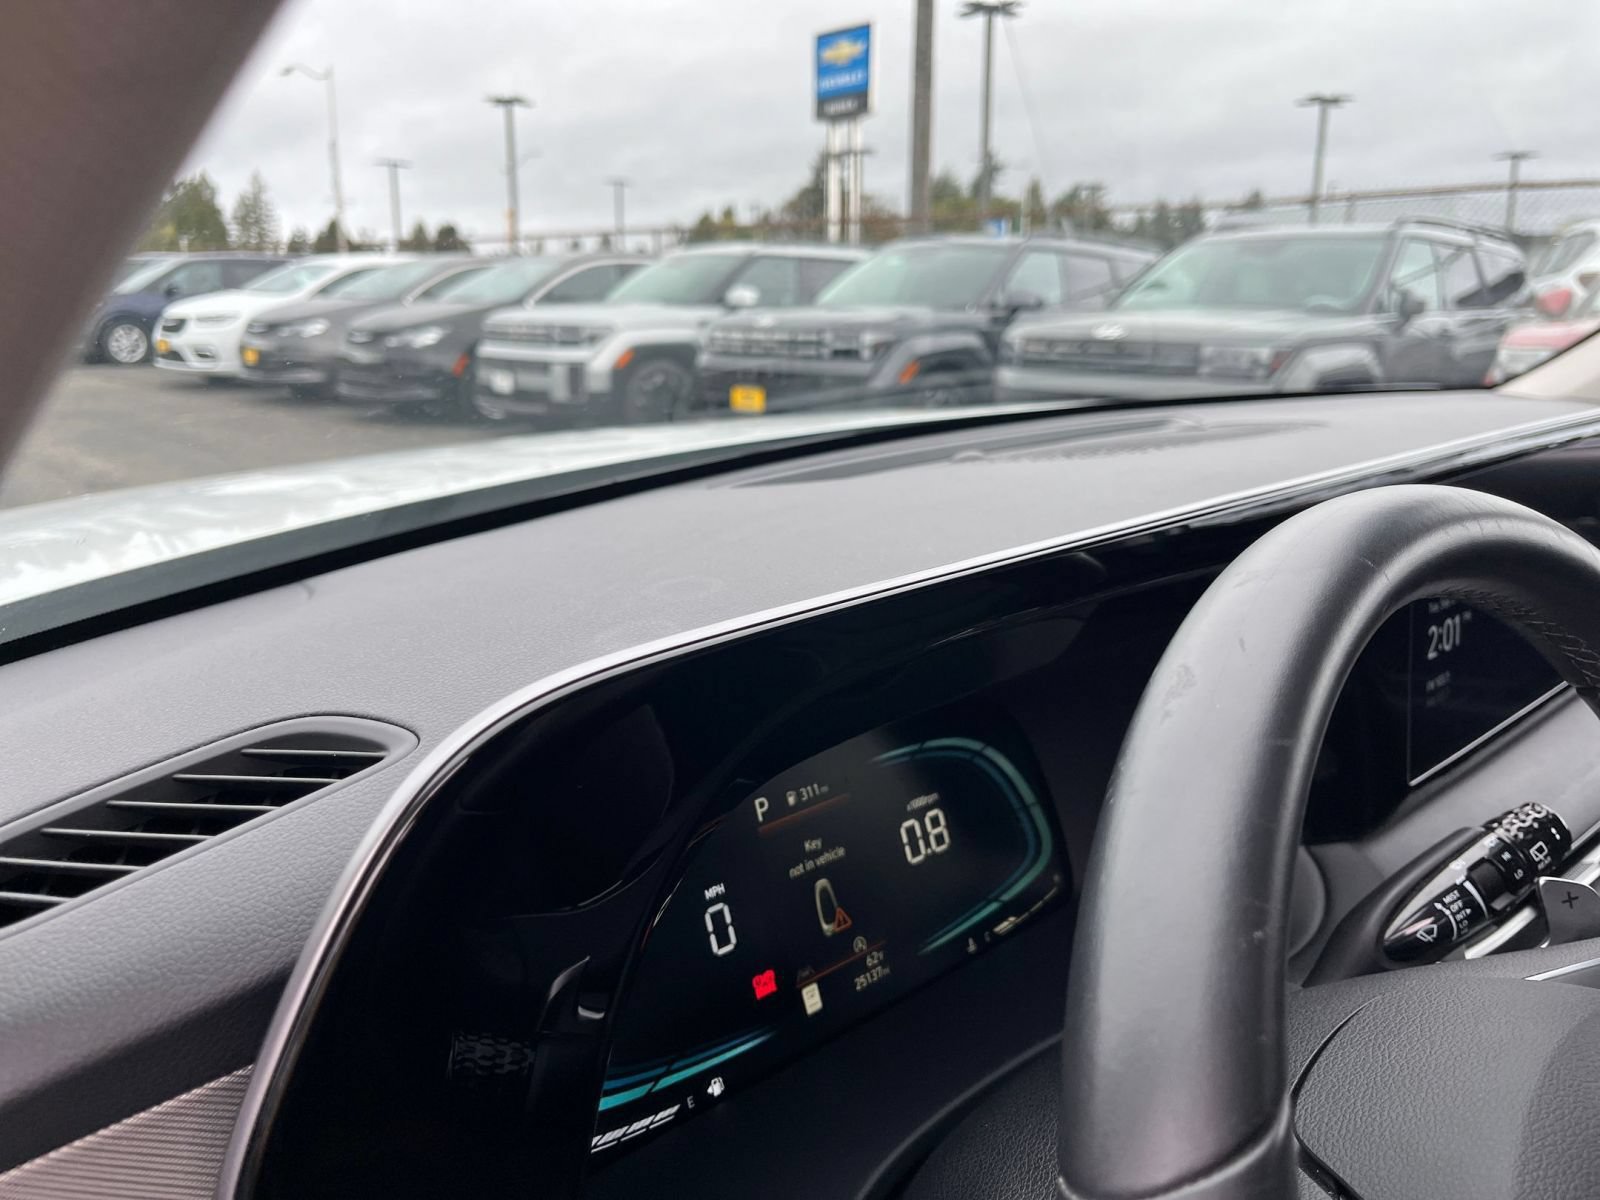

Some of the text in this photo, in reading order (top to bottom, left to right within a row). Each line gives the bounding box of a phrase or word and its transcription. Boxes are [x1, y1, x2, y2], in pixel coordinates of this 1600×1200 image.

[1427, 614, 1460, 660] 2:01
[754, 797, 769, 822] P
[804, 838, 822, 852] Key
[900, 808, 950, 865] 0.8
[789, 847, 845, 879] not in vehicle
[704, 882, 725, 900] MPH
[1442, 890, 1461, 905] MIST
[704, 902, 737, 956] 0
[687, 1095, 695, 1109] E
